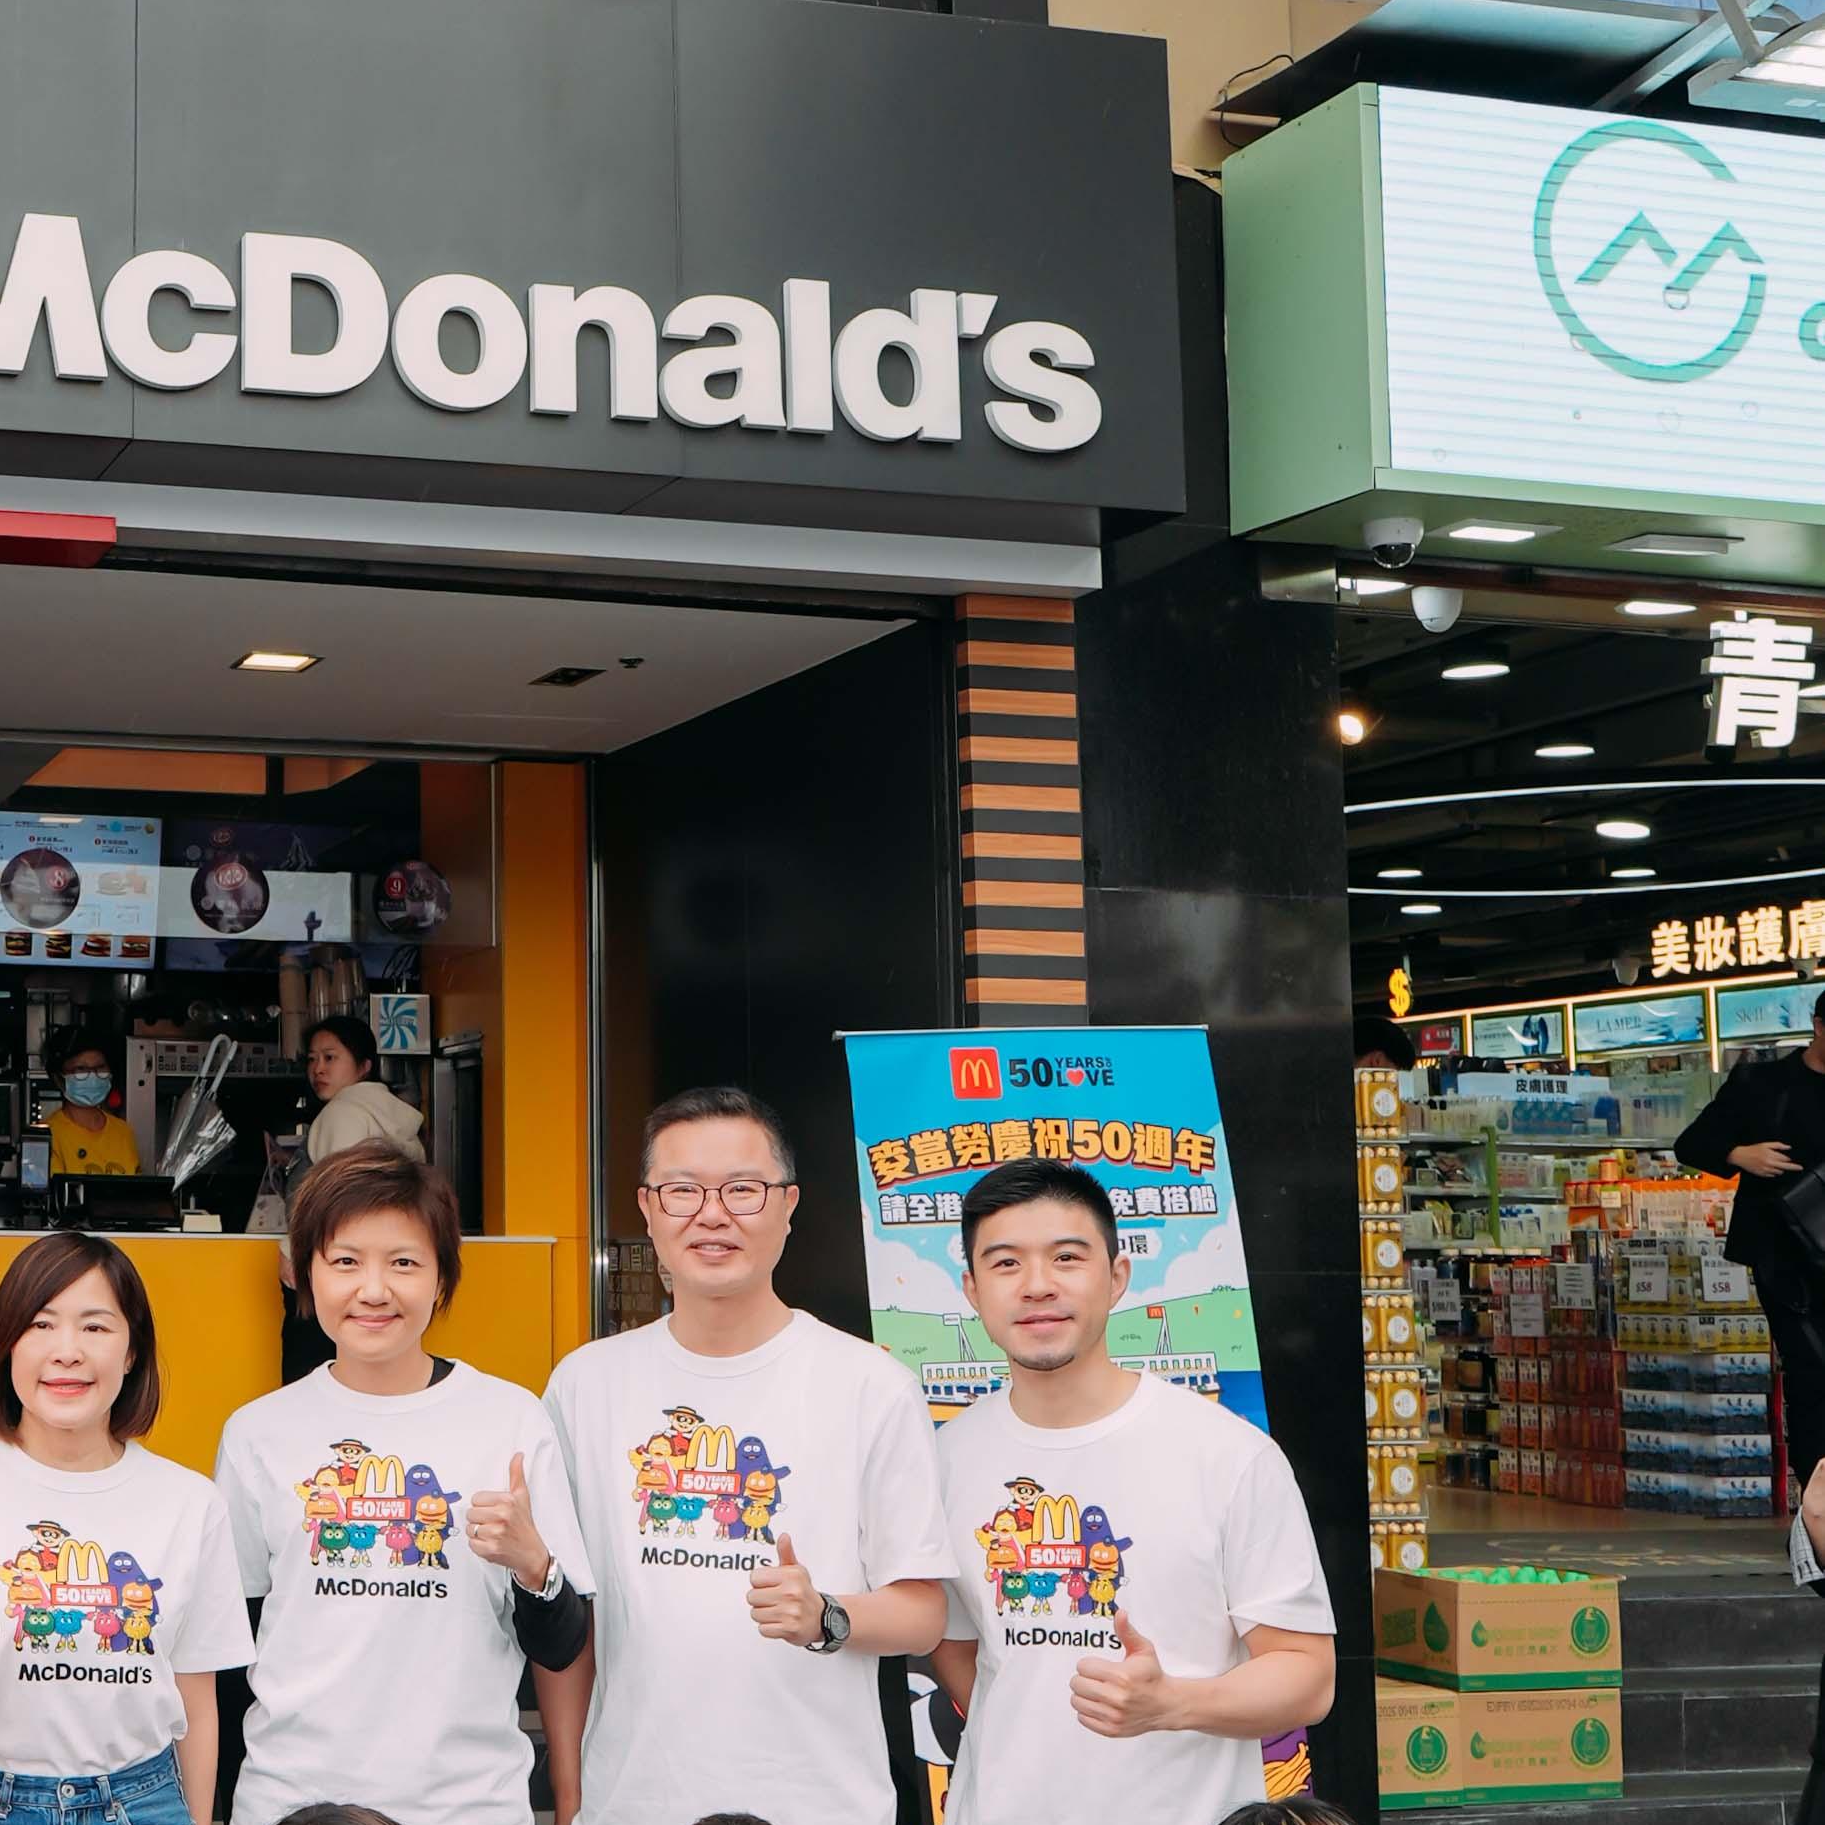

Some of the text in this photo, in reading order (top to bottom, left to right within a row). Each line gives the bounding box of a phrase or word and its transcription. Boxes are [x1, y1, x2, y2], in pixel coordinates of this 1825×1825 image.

[1008, 1057, 1054, 1088] 50
[1055, 1056, 1105, 1069] YEARS
[351, 1500, 376, 1517] 50
[1030, 1548, 1055, 1565] 50
[314, 1577, 448, 1599] McDonald's
[18, 1663, 152, 1685] McDonald's
